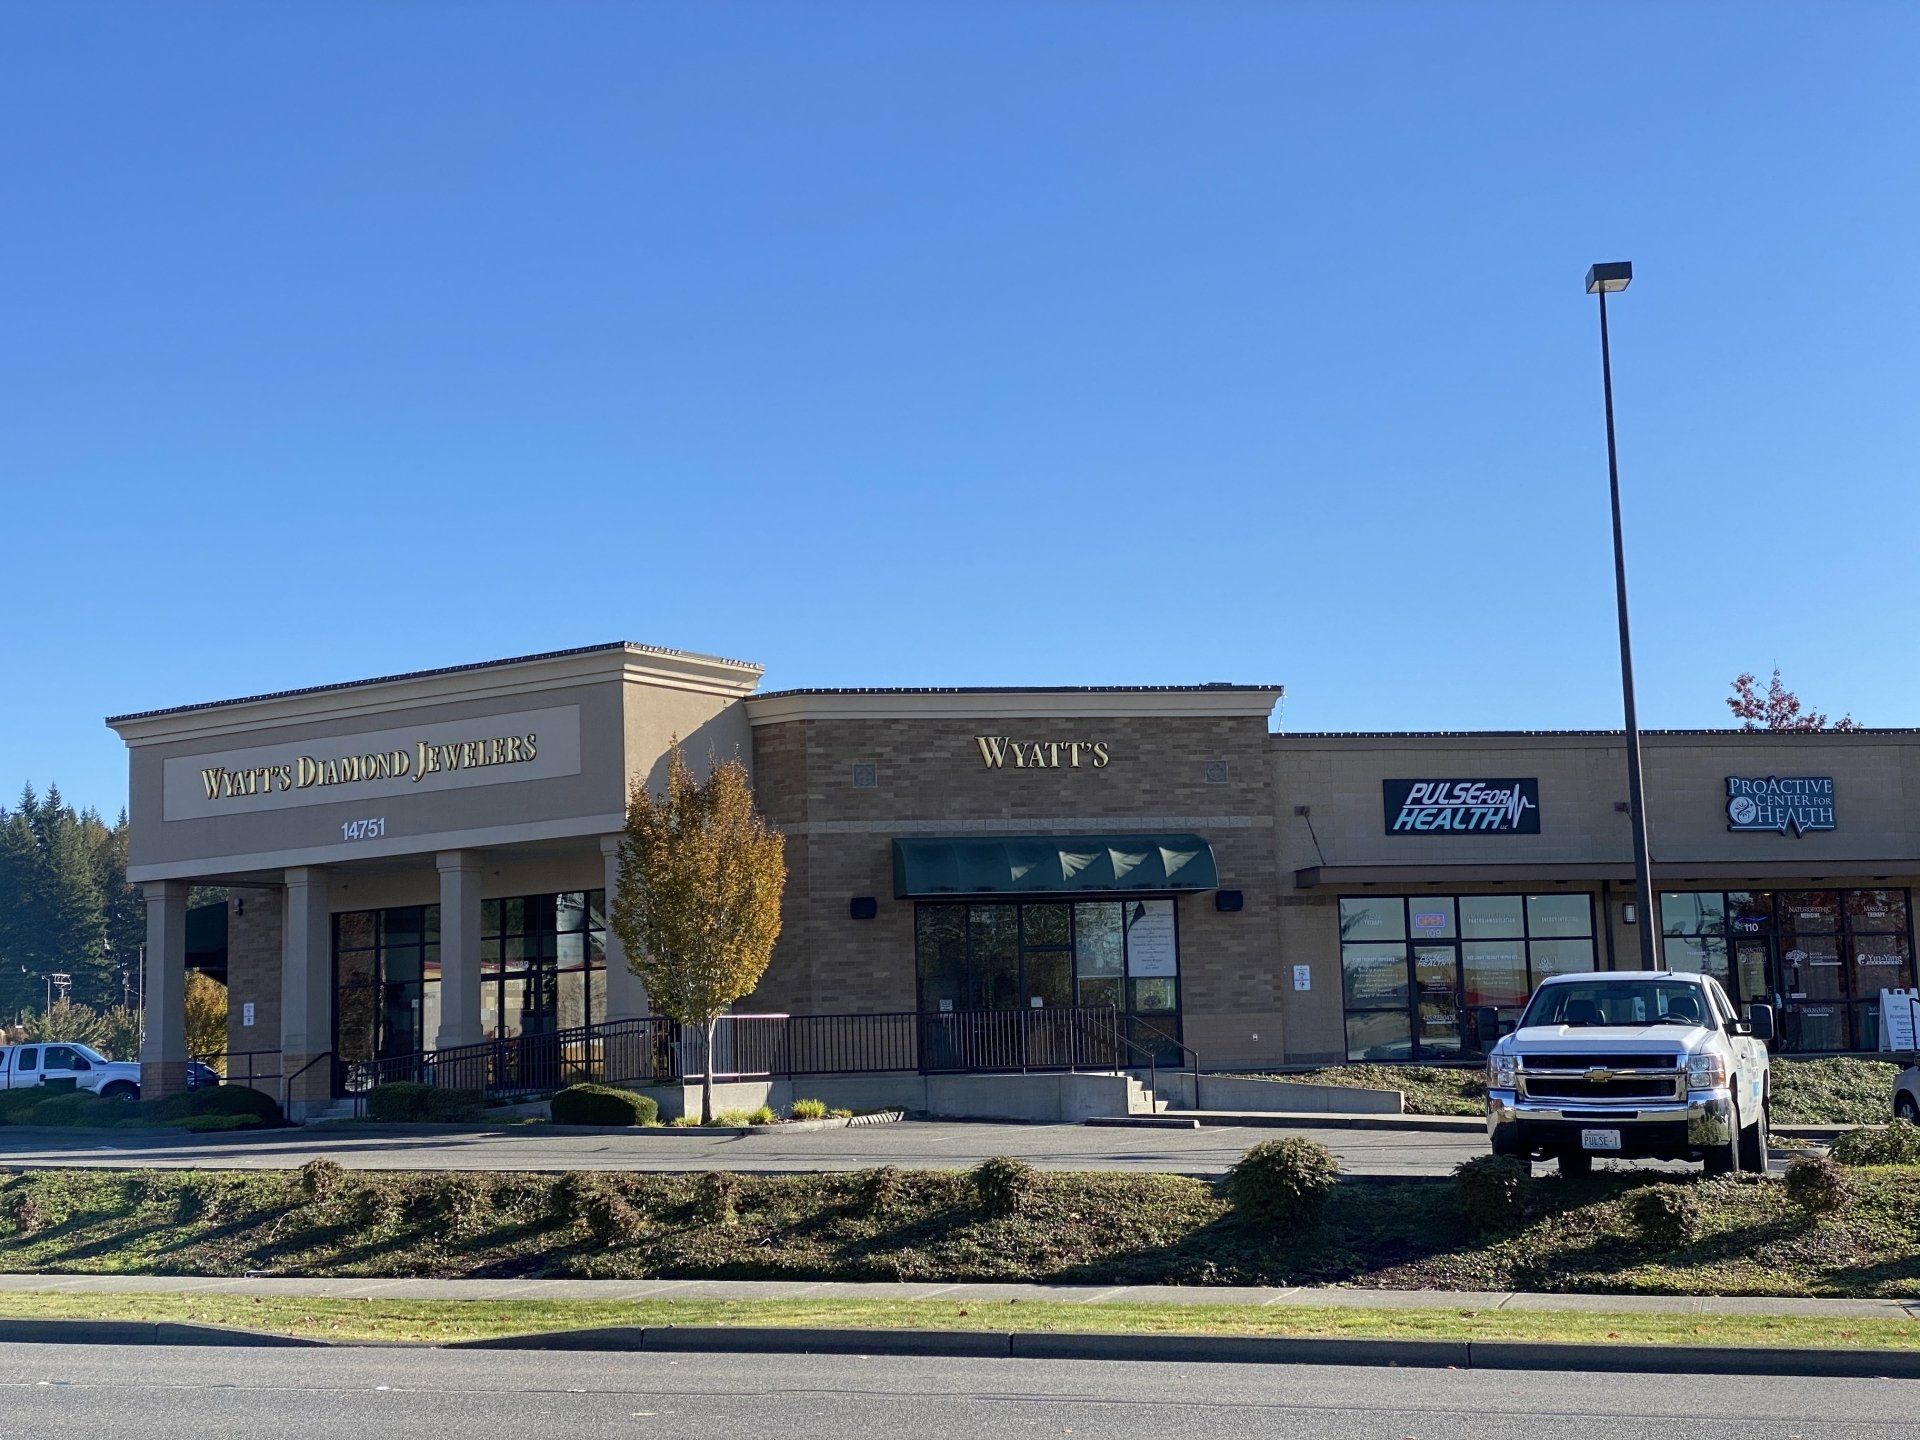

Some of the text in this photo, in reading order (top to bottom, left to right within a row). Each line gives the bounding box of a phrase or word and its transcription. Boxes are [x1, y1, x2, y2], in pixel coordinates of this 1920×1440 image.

[974, 736, 1109, 769] WYATT'S
[200, 733, 537, 799] WYATT'S DIAMOND JEWELERS
[1405, 783, 1510, 804] PULSE FOR
[1729, 778, 1833, 794] PROACTIVE
[1755, 794, 1832, 806] CENTER FOR
[1393, 808, 1507, 830] HEALTH
[1757, 806, 1833, 823] HEALTH
[341, 817, 386, 841] 14751
[1425, 929, 1442, 937] 109
[1744, 923, 1759, 932] 110
